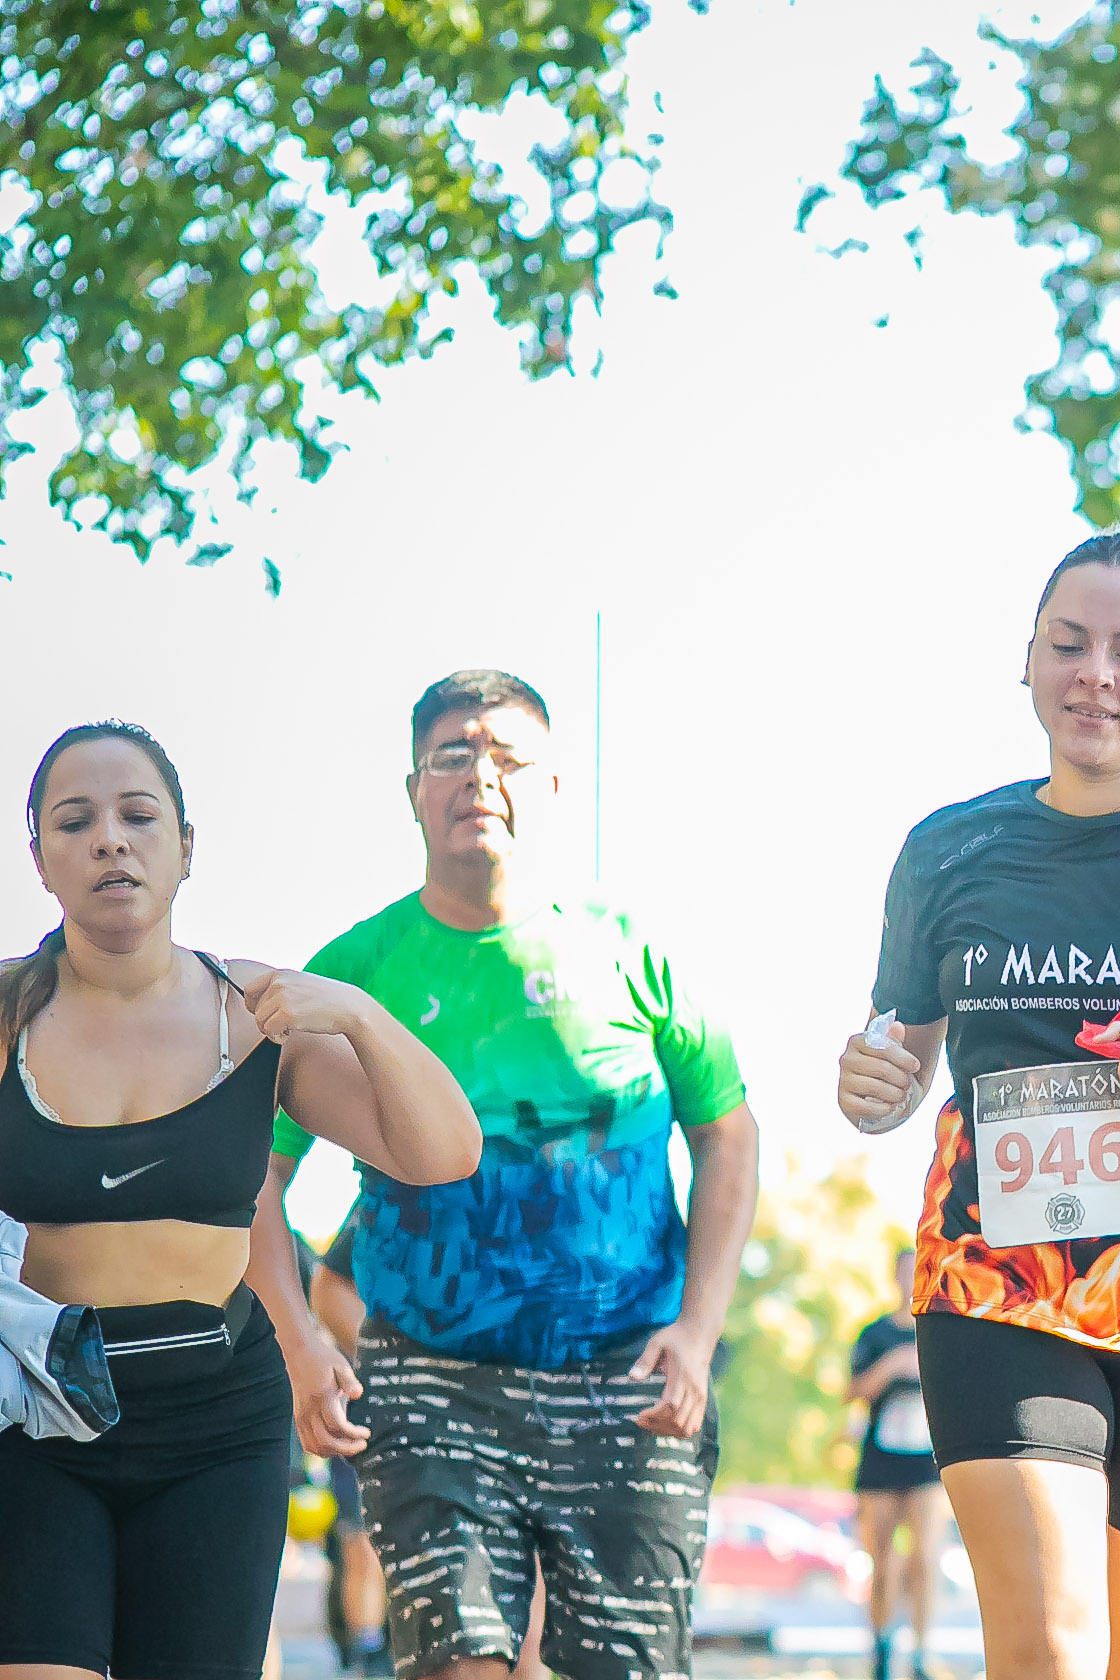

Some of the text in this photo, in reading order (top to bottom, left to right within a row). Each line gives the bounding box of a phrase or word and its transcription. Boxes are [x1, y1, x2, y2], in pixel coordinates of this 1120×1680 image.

[955, 994, 1008, 1012] ASOCIACIÓN
[1011, 996, 1080, 1010] BOMBEROS
[1060, 1099, 1113, 1113] VOLUNTARIOS
[1056, 1205, 1073, 1221] 27
